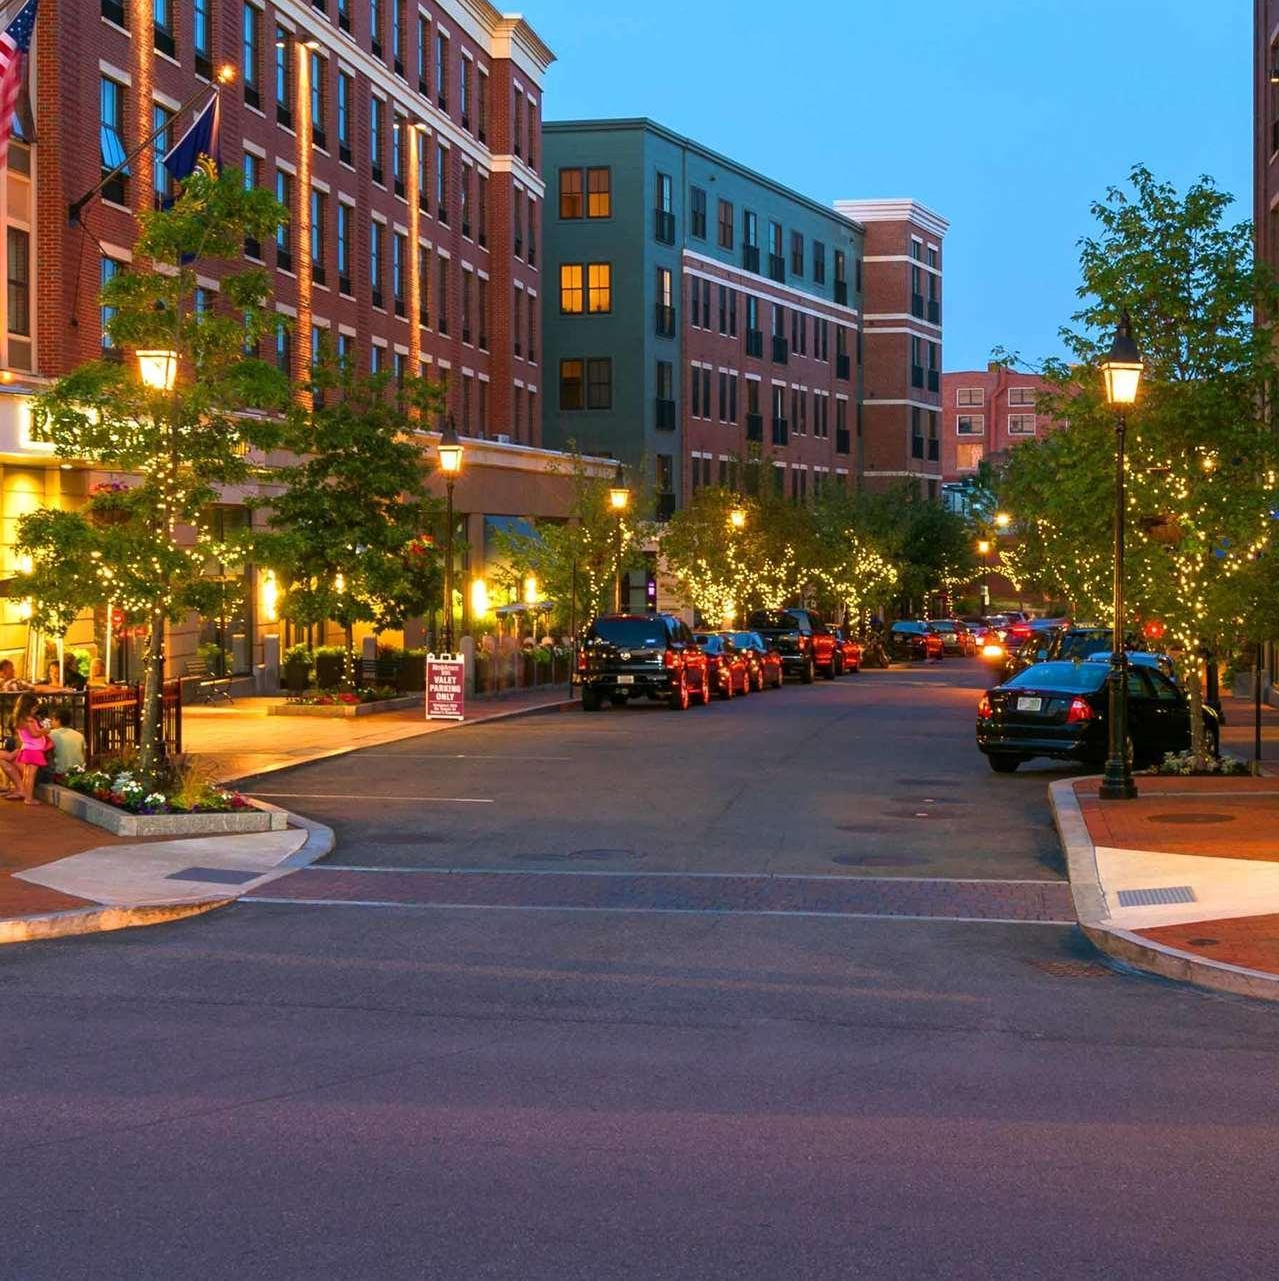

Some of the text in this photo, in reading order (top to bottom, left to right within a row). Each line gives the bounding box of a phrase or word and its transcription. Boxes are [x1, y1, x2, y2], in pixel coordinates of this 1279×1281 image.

[434, 675, 457, 684] VALET
[429, 684, 461, 693] PARKING
[436, 693, 455, 701] ONLY
